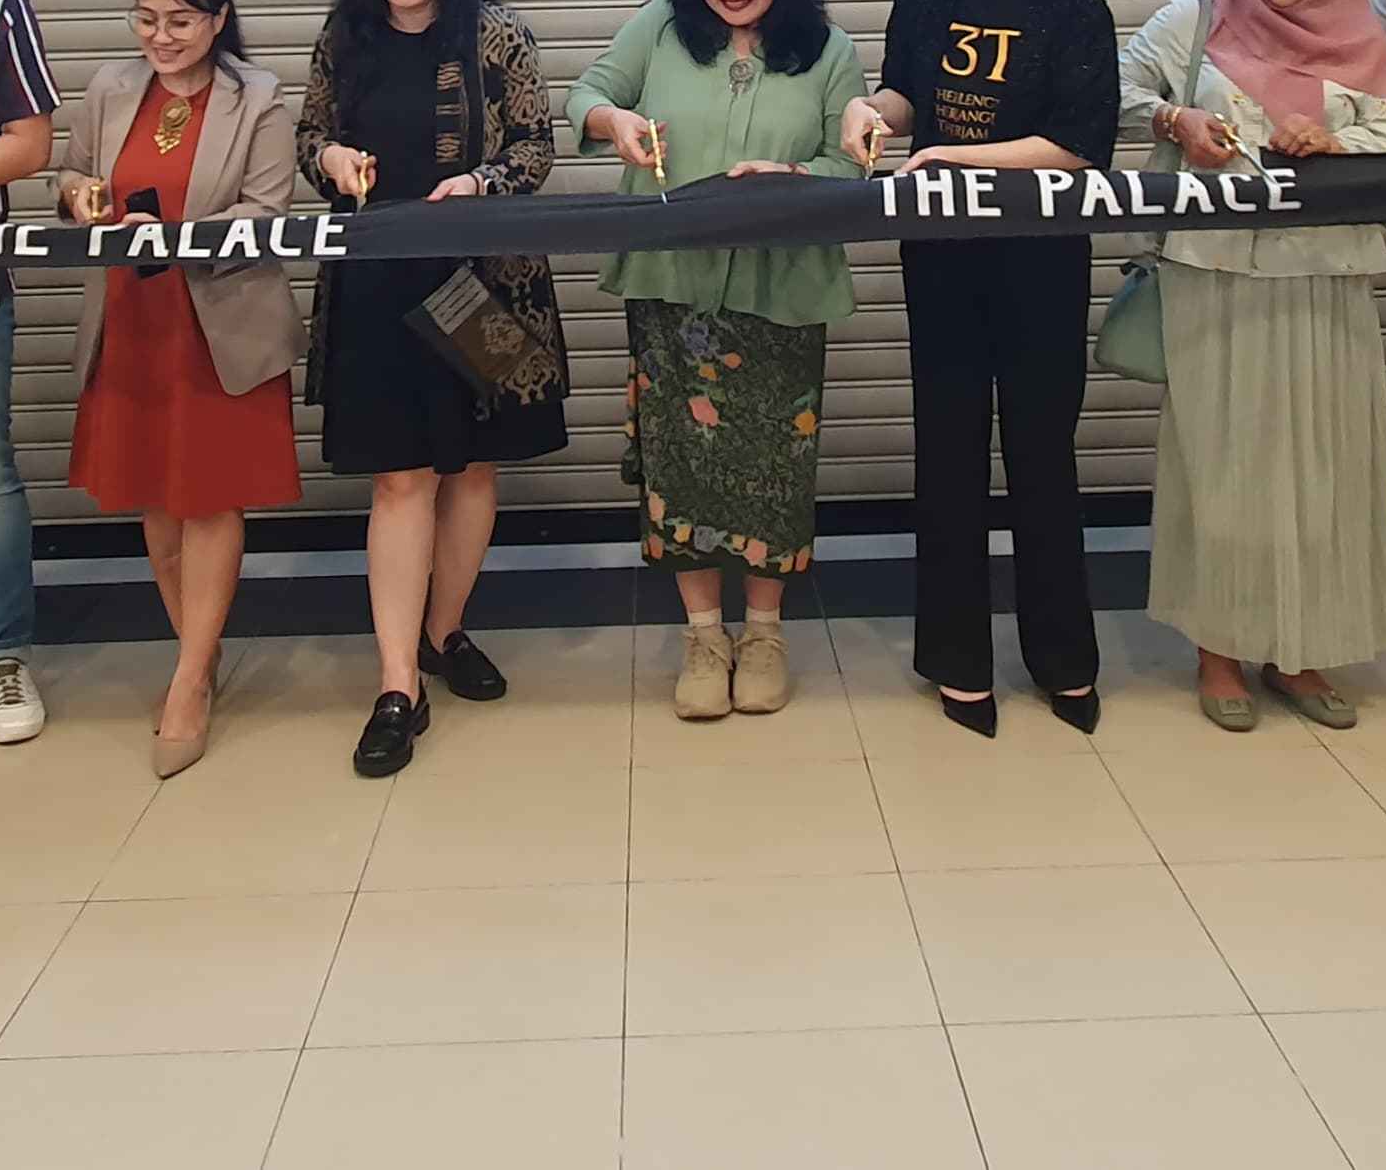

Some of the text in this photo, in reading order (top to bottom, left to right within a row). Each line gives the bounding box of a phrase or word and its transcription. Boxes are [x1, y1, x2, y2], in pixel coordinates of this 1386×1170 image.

[941, 22, 1022, 82] 3T
[870, 167, 1303, 217] THE PALACE
